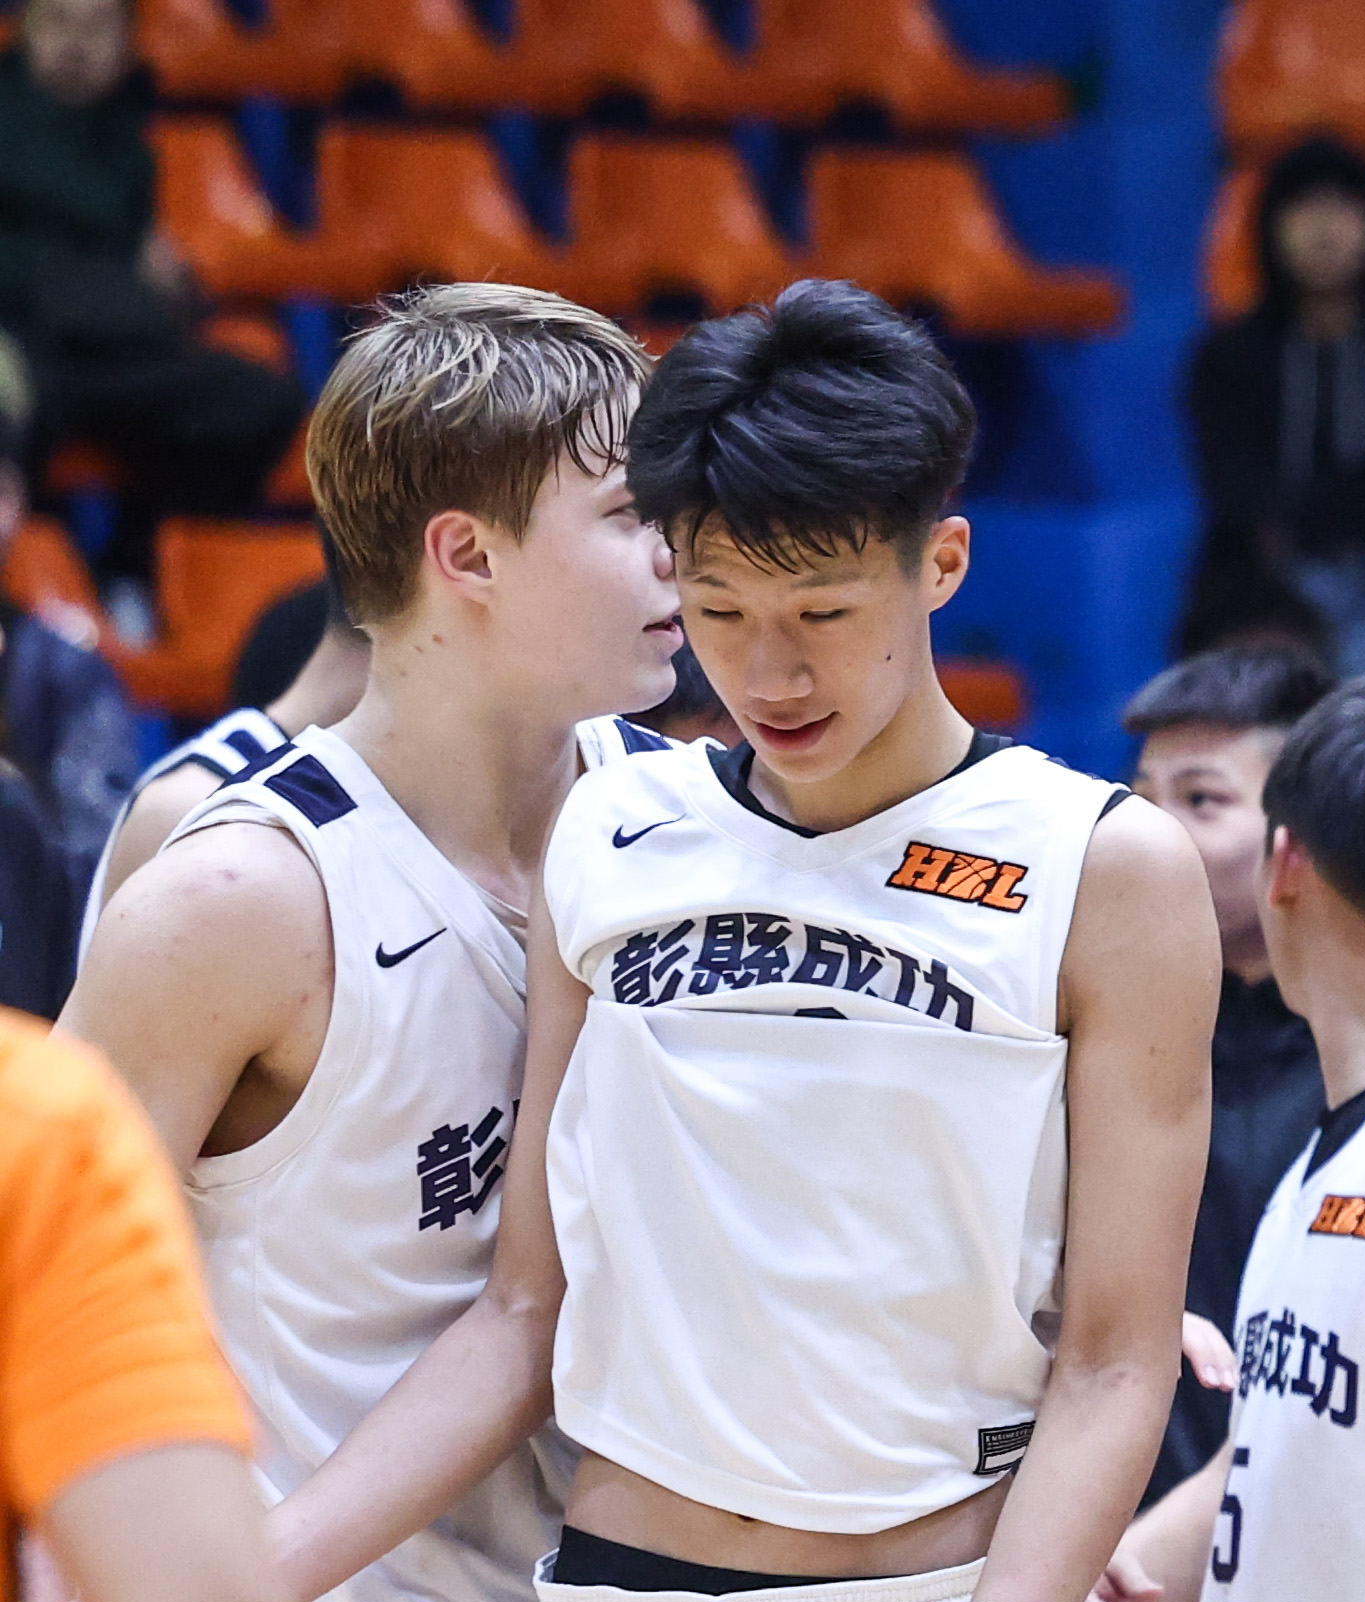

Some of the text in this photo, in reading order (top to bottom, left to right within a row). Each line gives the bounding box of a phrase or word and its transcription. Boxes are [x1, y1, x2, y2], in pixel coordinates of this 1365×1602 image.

[611, 912, 974, 1032] 彰縣成功
[417, 1099, 519, 1231] 彰
[1238, 1307, 1358, 1428] 縣成功
